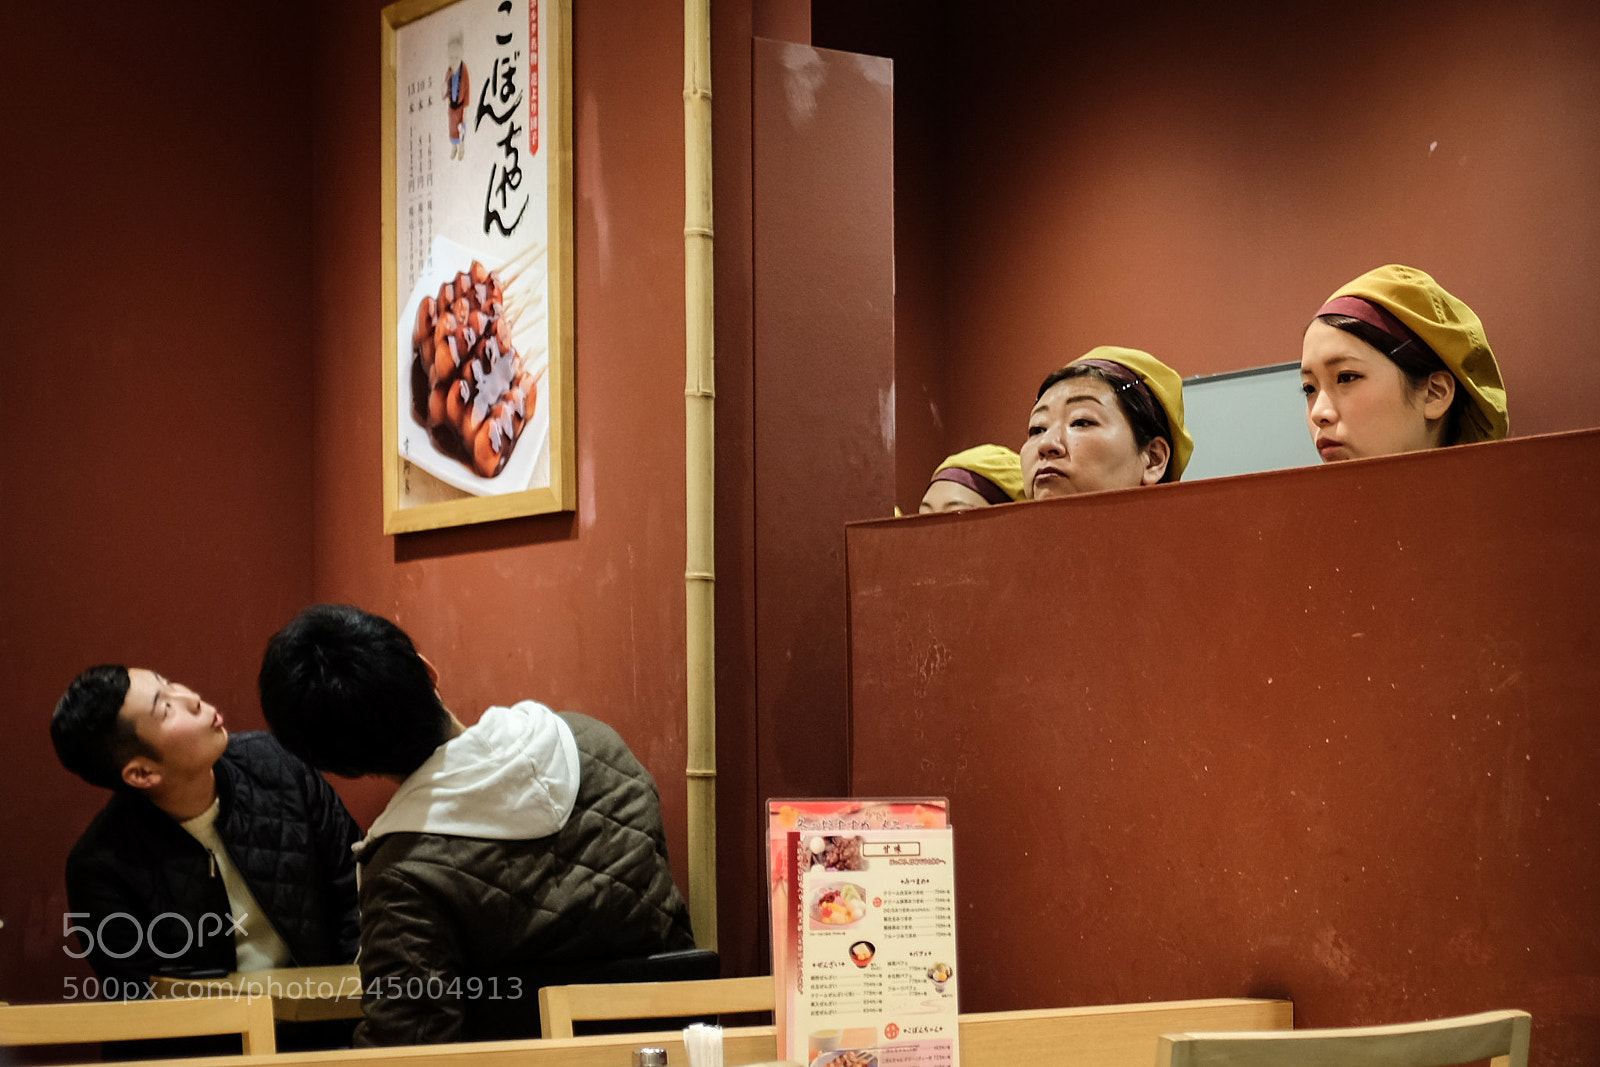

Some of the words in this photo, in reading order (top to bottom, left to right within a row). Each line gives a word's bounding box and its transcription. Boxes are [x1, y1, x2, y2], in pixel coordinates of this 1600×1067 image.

[475, 0, 530, 237] こぼんちゃん
